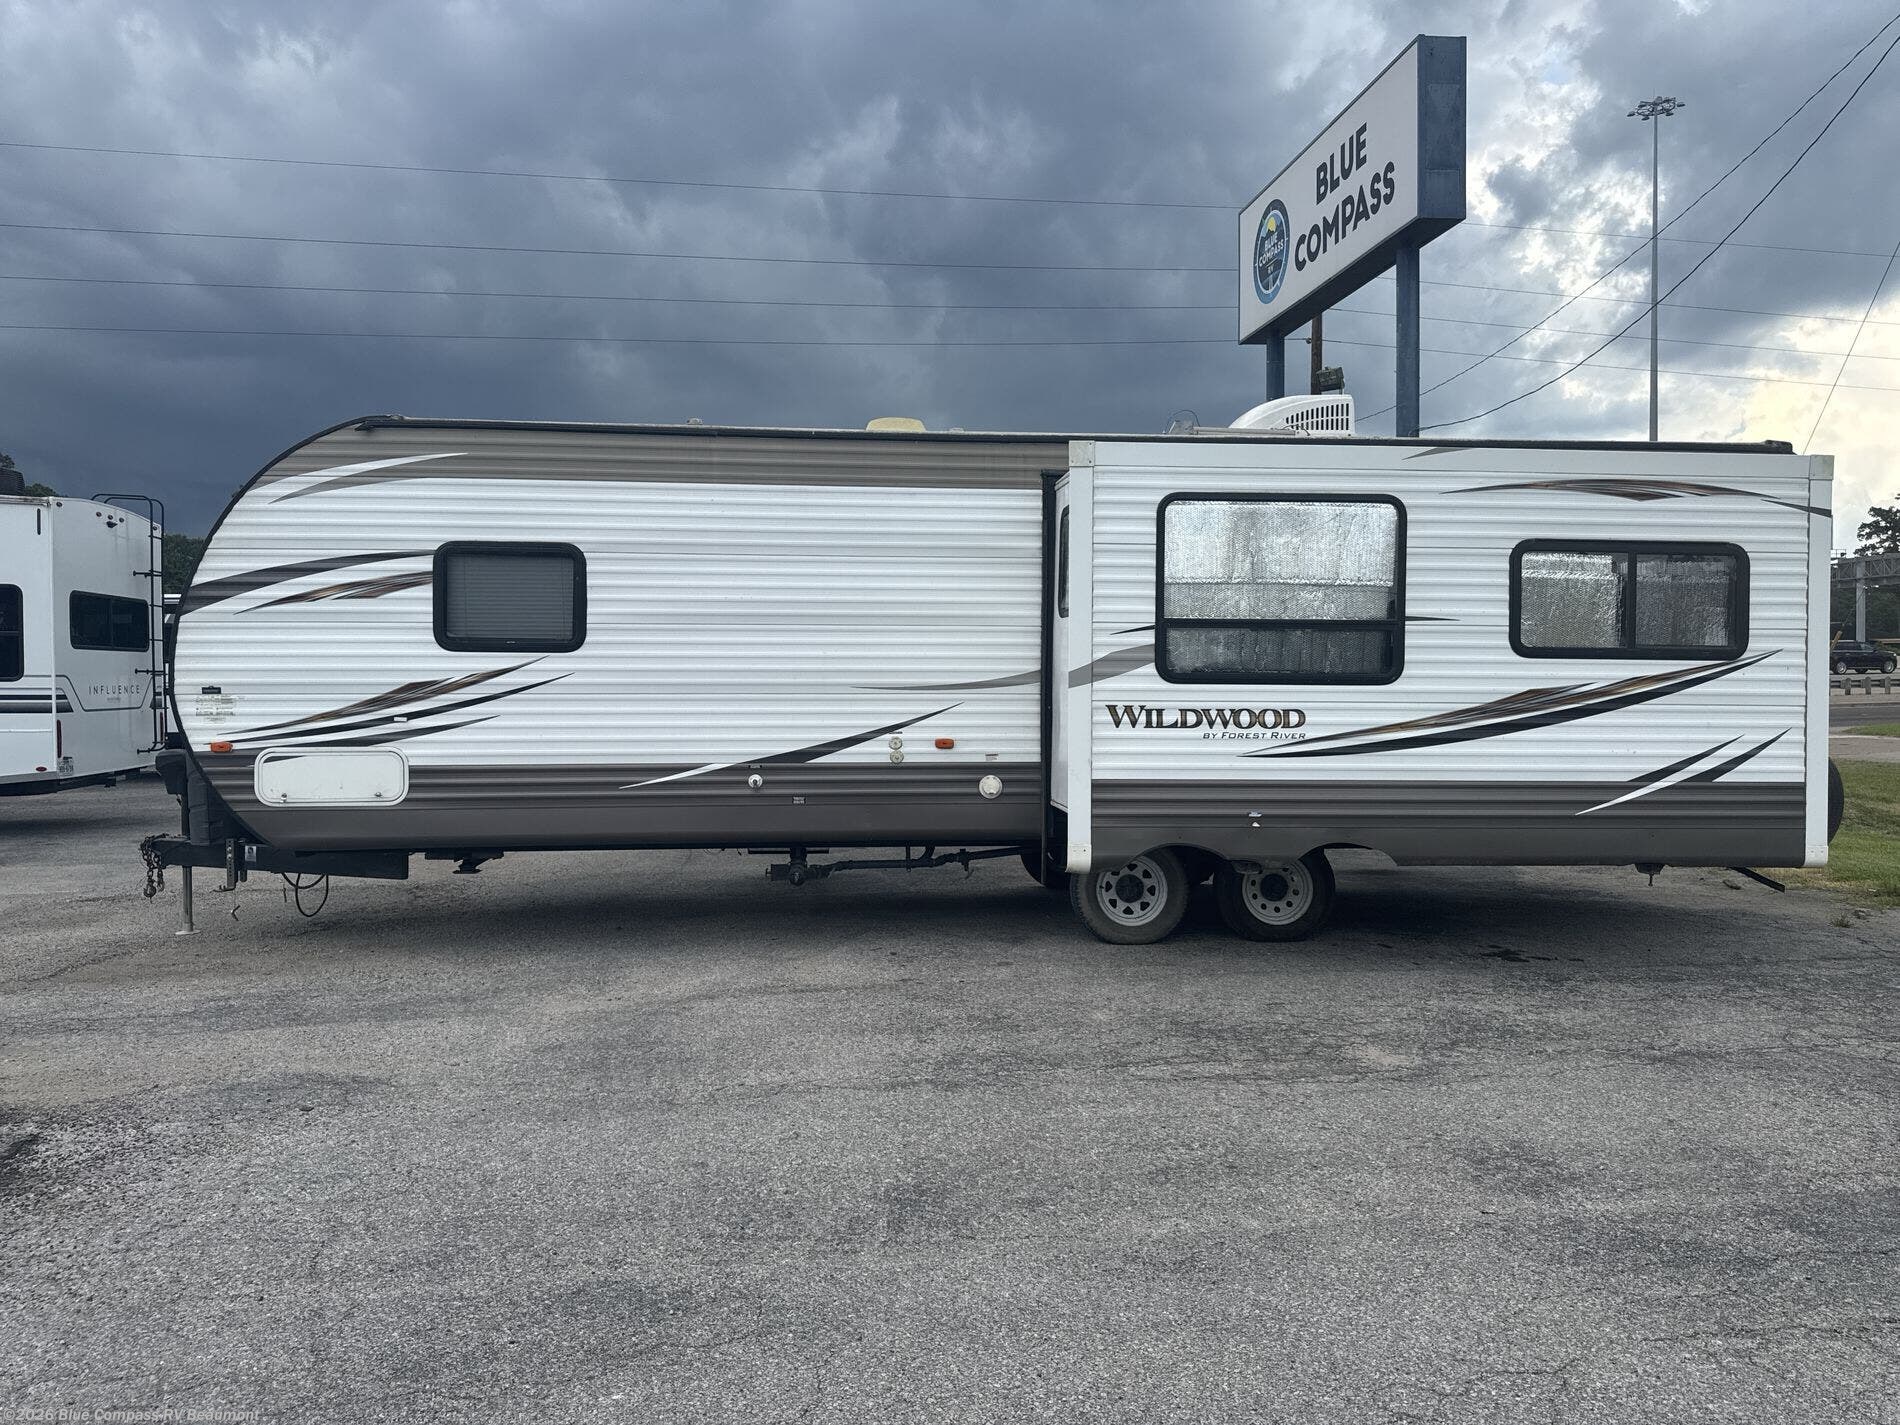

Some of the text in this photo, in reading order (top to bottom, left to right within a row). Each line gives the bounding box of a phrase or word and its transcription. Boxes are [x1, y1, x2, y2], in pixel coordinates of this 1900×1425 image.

[1316, 122, 1367, 205] BLUE
[1295, 162, 1395, 271] COMPASS
[88, 685, 140, 695] INFLUENCE
[1105, 704, 1306, 729] WILDWOOD
